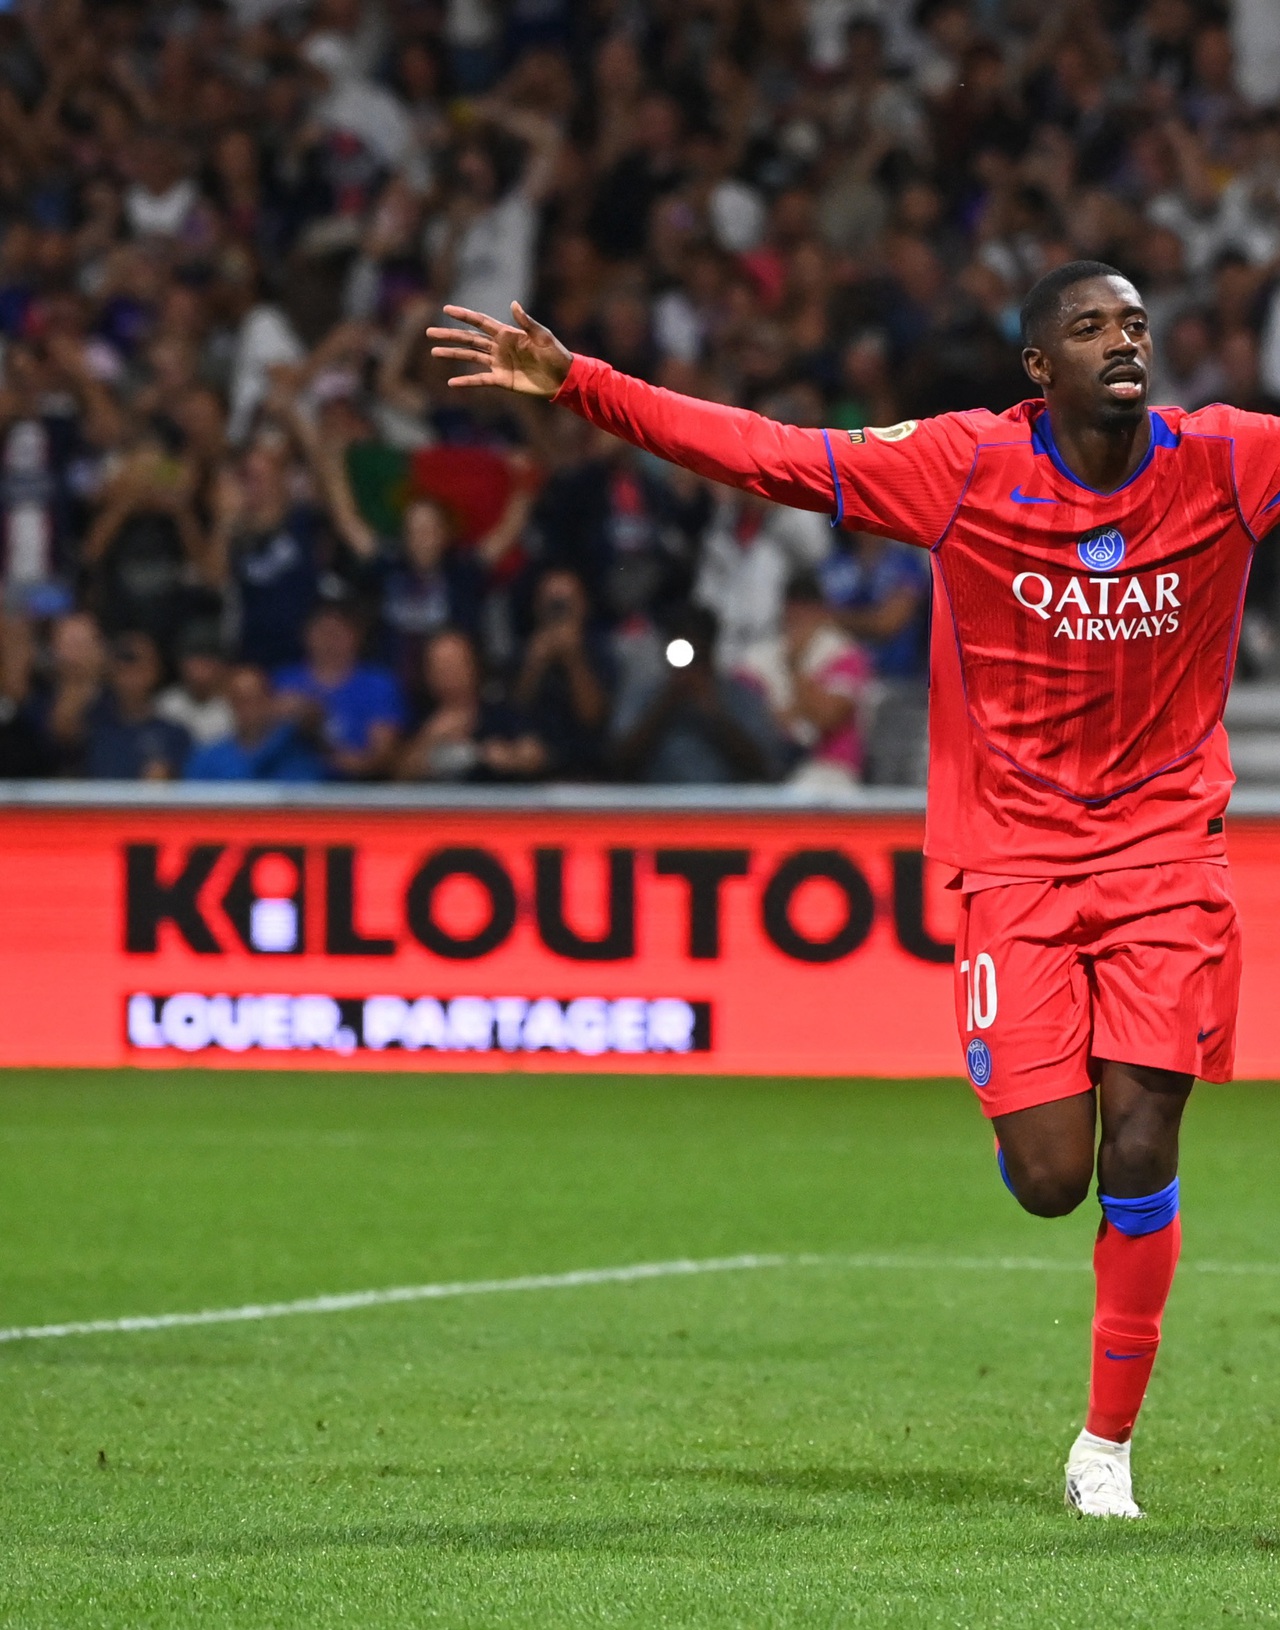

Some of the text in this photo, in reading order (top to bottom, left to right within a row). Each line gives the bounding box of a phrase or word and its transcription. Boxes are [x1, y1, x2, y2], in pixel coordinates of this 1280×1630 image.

[1011, 571, 1182, 620] QATAR
[1053, 610, 1180, 641] AIRWAYS
[960, 952, 998, 1032] 10
[362, 995, 695, 1055] PARTAGER
